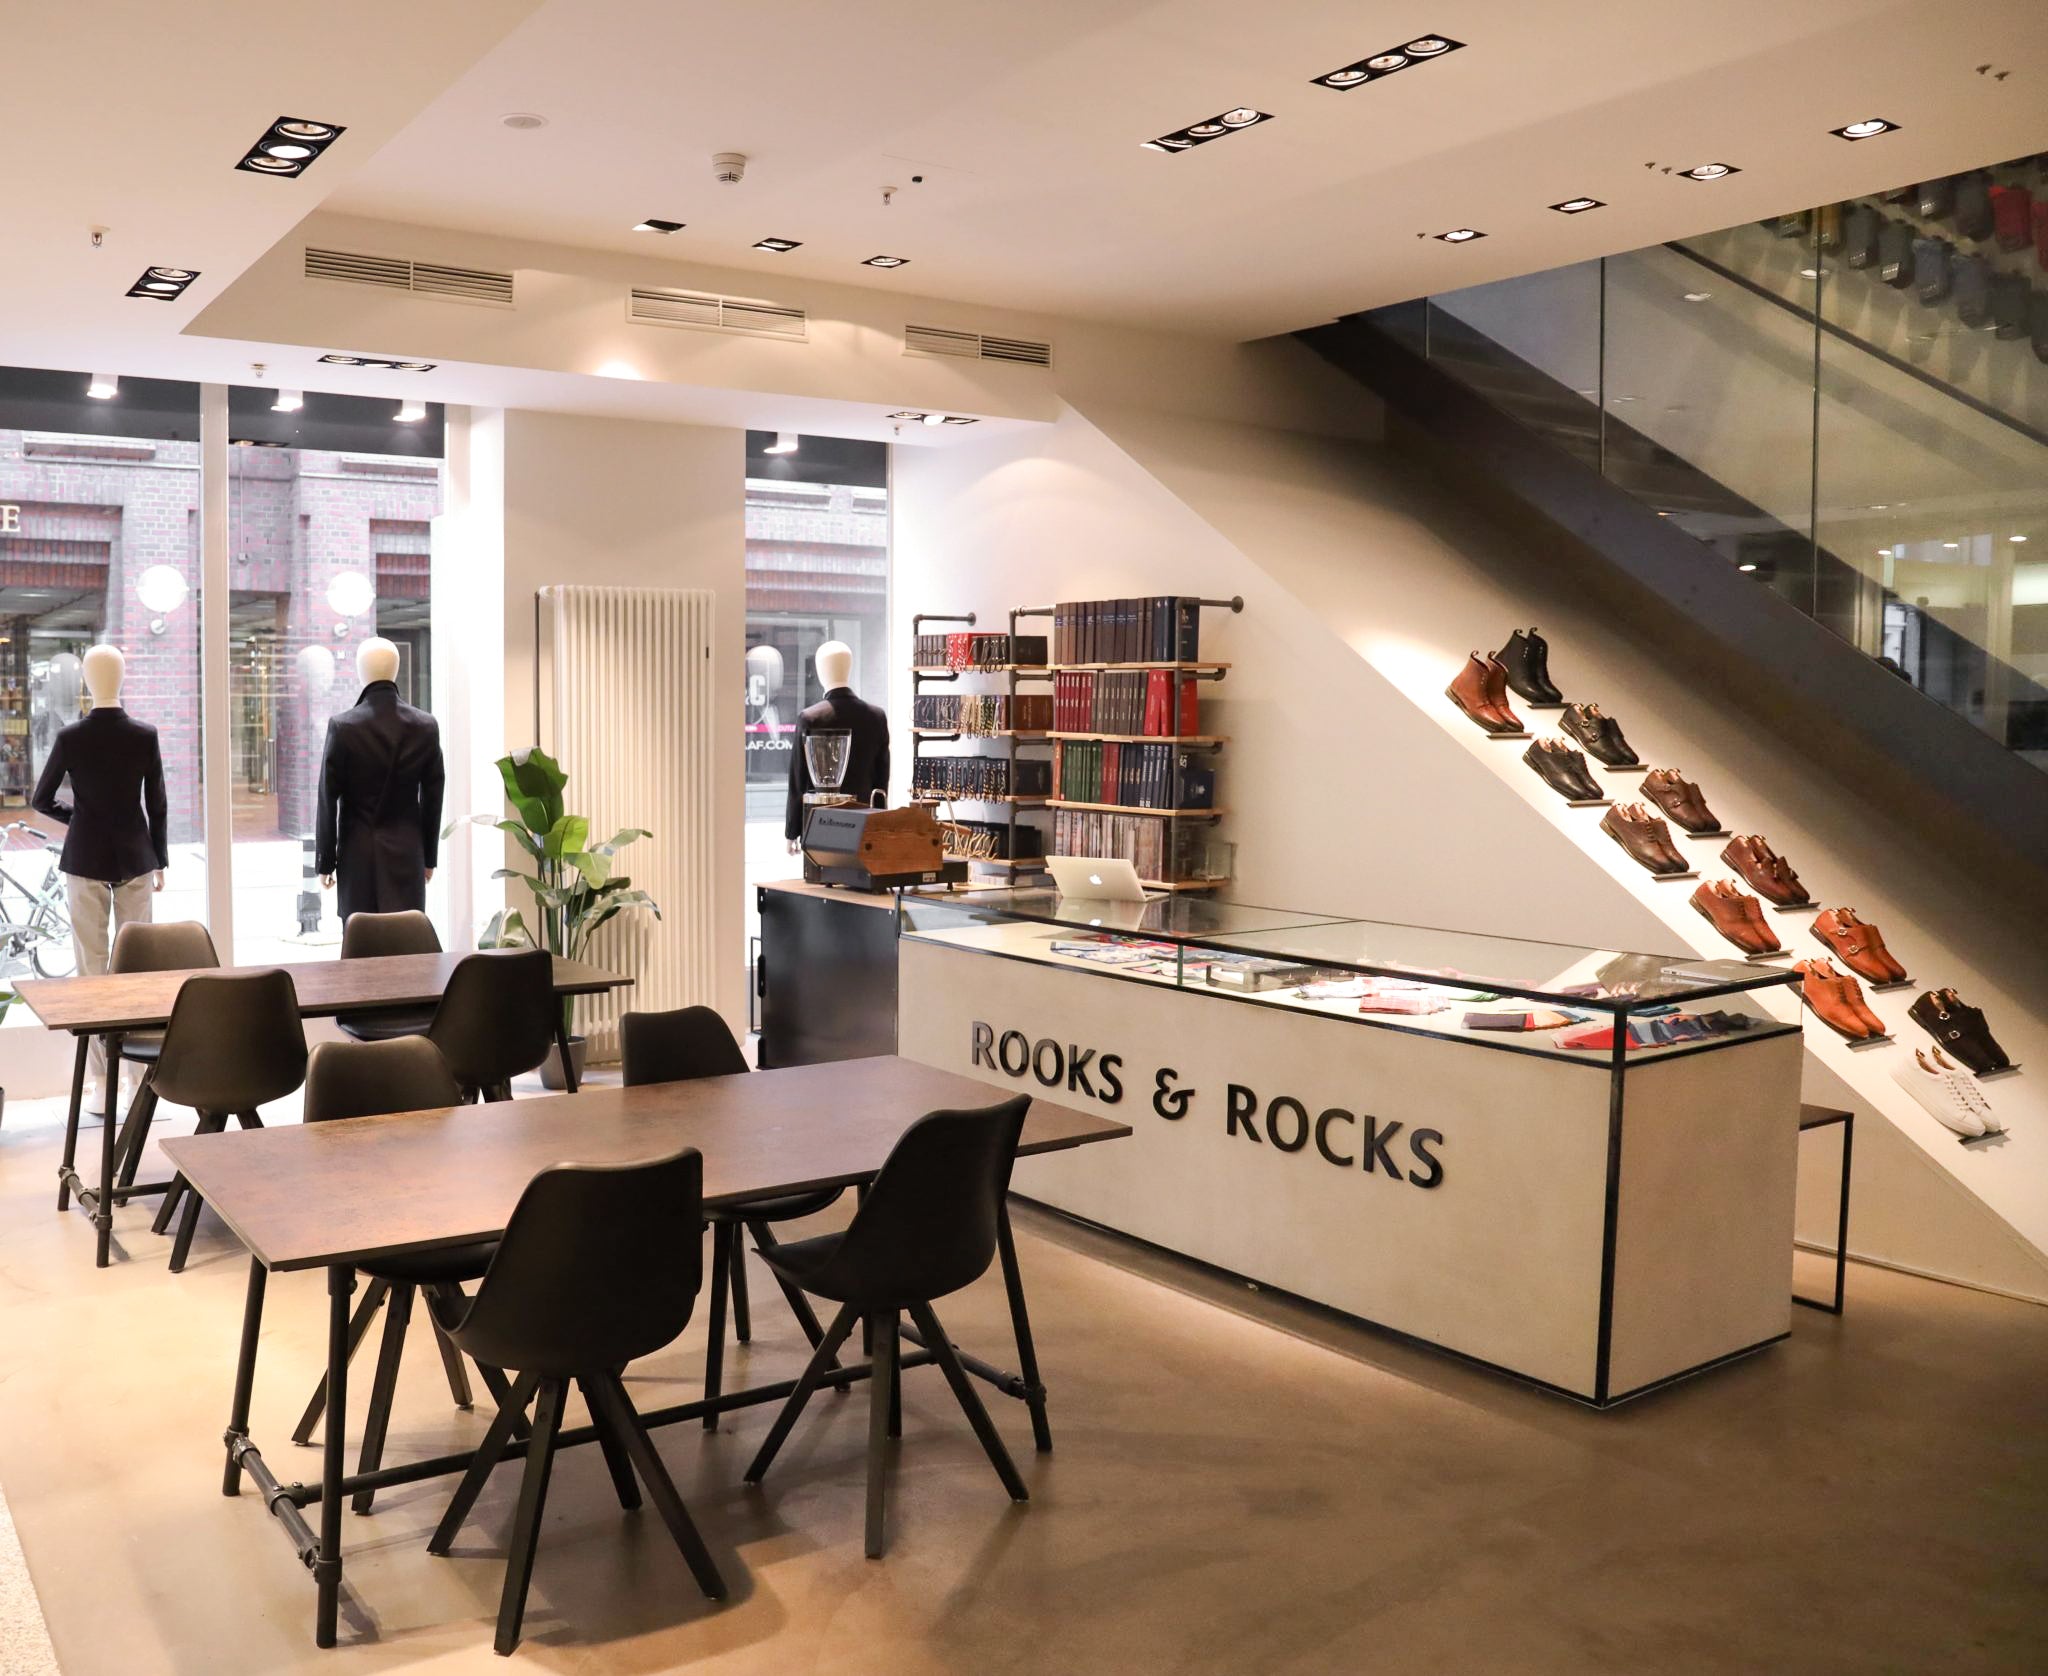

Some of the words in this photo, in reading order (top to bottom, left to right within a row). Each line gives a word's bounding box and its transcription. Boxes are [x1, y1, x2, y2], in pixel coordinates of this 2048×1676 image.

[0, 505, 20, 532] E
[971, 1021, 1123, 1104] ROOKS
[1153, 1067, 1195, 1120] &
[1226, 1083, 1443, 1189] ROCKS
